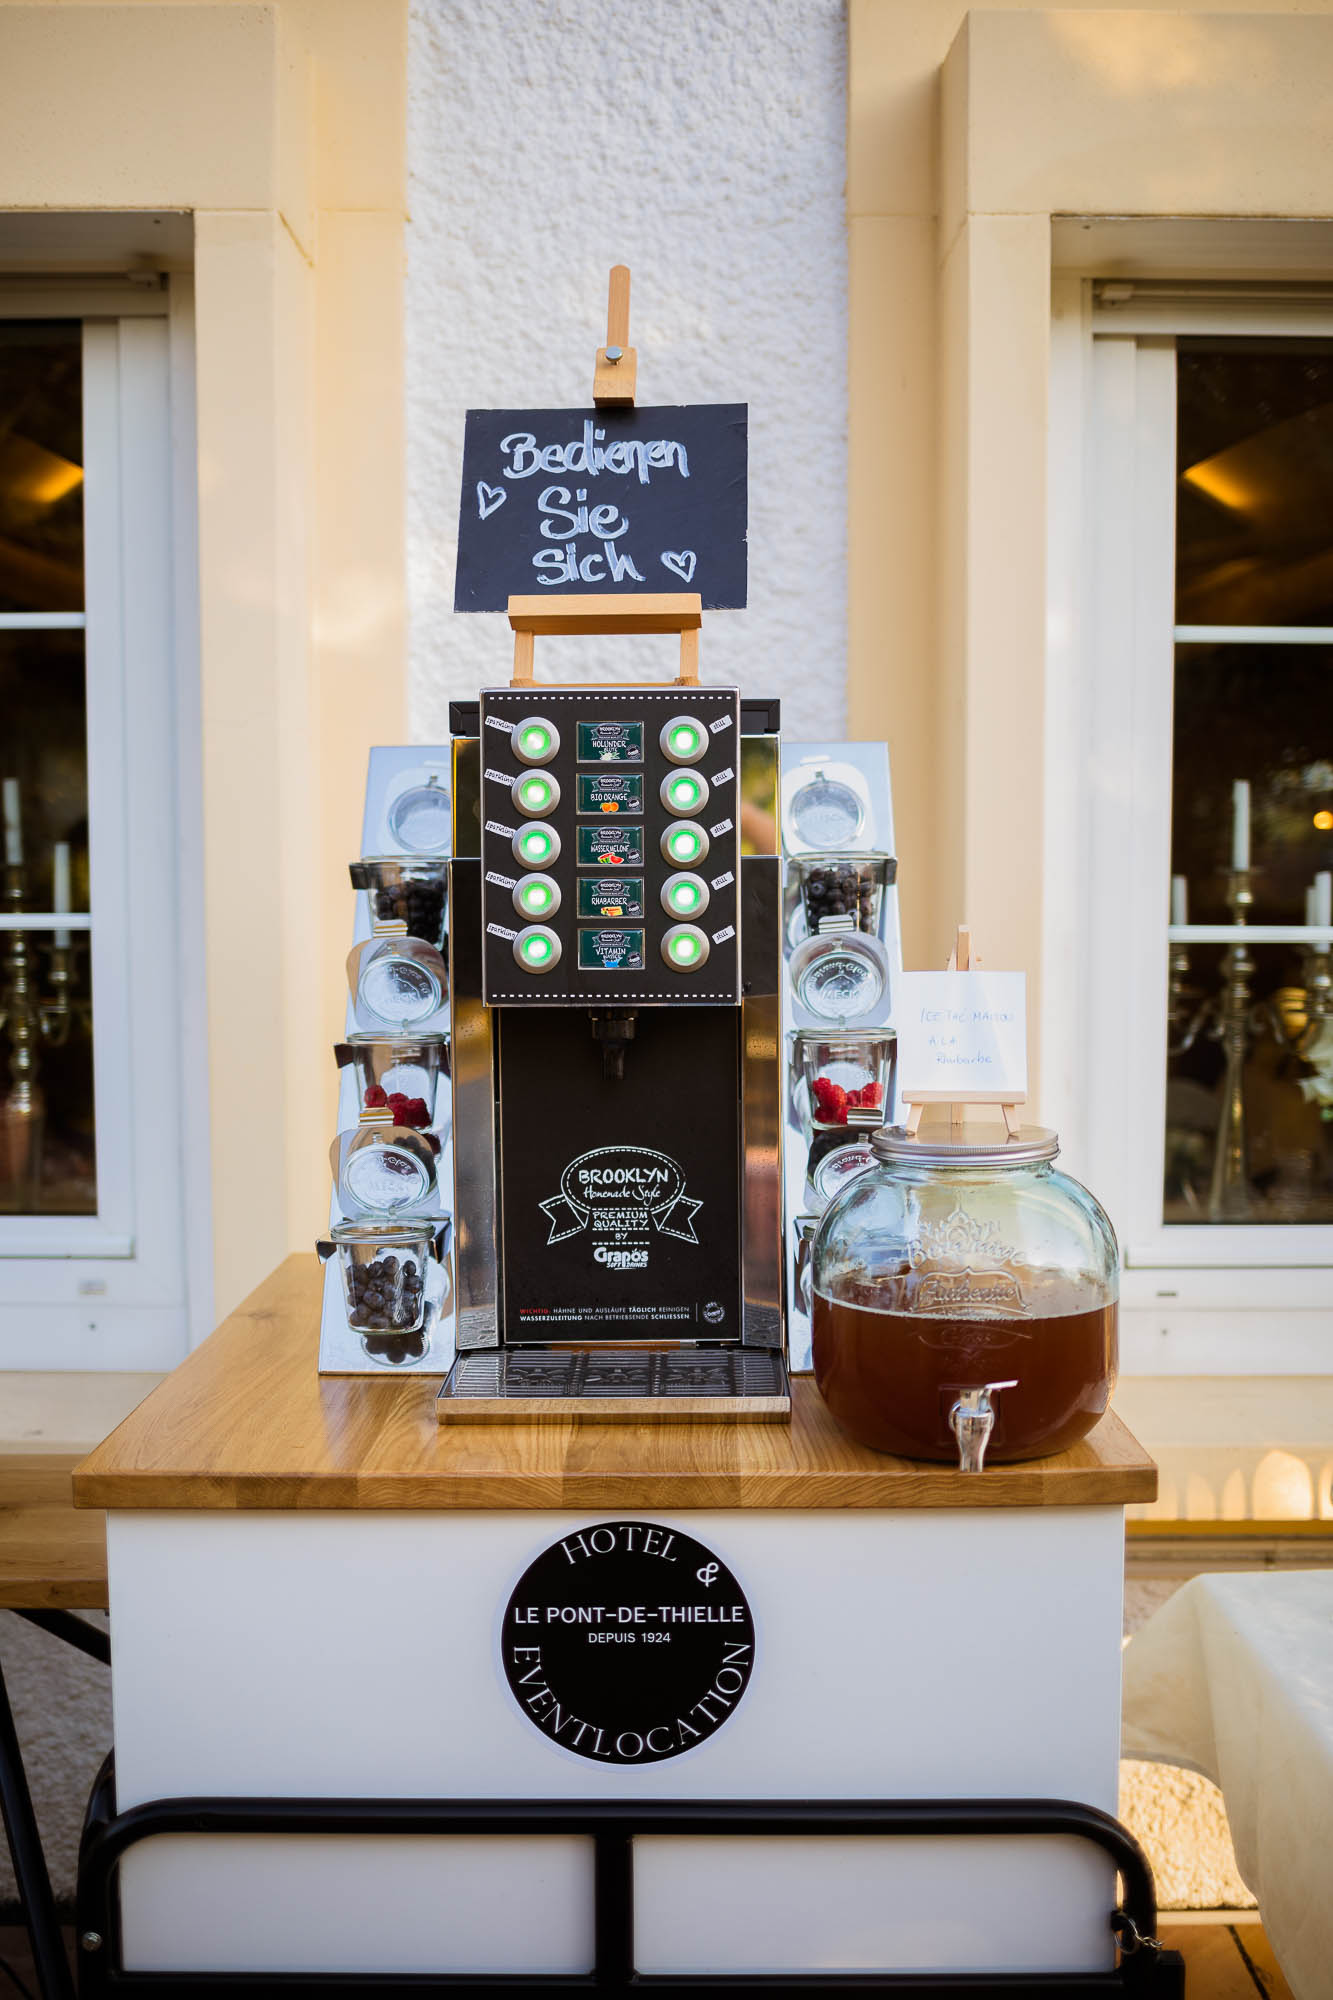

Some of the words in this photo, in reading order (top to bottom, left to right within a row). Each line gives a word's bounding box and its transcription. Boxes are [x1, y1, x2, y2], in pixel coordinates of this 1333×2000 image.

[500, 419, 690, 485] Bedienen
[537, 485, 629, 540] Sie
[592, 740, 627, 748] HOLUNDER
[590, 793, 602, 801] BIO
[603, 793, 628, 801] ORANGE
[591, 897, 627, 905] RHABARBER
[595, 946, 626, 955] VITAMIN
[578, 1167, 669, 1185] BROOKLYN
[583, 1186, 631, 1200] Homemade
[631, 1184, 661, 1207] Style
[592, 1211, 648, 1219] PREMIUM
[593, 1219, 649, 1228] QUALITY
[615, 1232, 628, 1240] BY
[628, 1305, 657, 1313] TÄGLICH
[560, 1526, 678, 1565] HOTEL
[696, 1562, 719, 1587] &
[515, 1607, 539, 1623] LE
[547, 1606, 744, 1623] PONT-DE-THIELLE
[588, 1632, 636, 1643] DEPUIS
[641, 1632, 671, 1643] 1924
[513, 1642, 751, 1757] EVENTLOCATION
